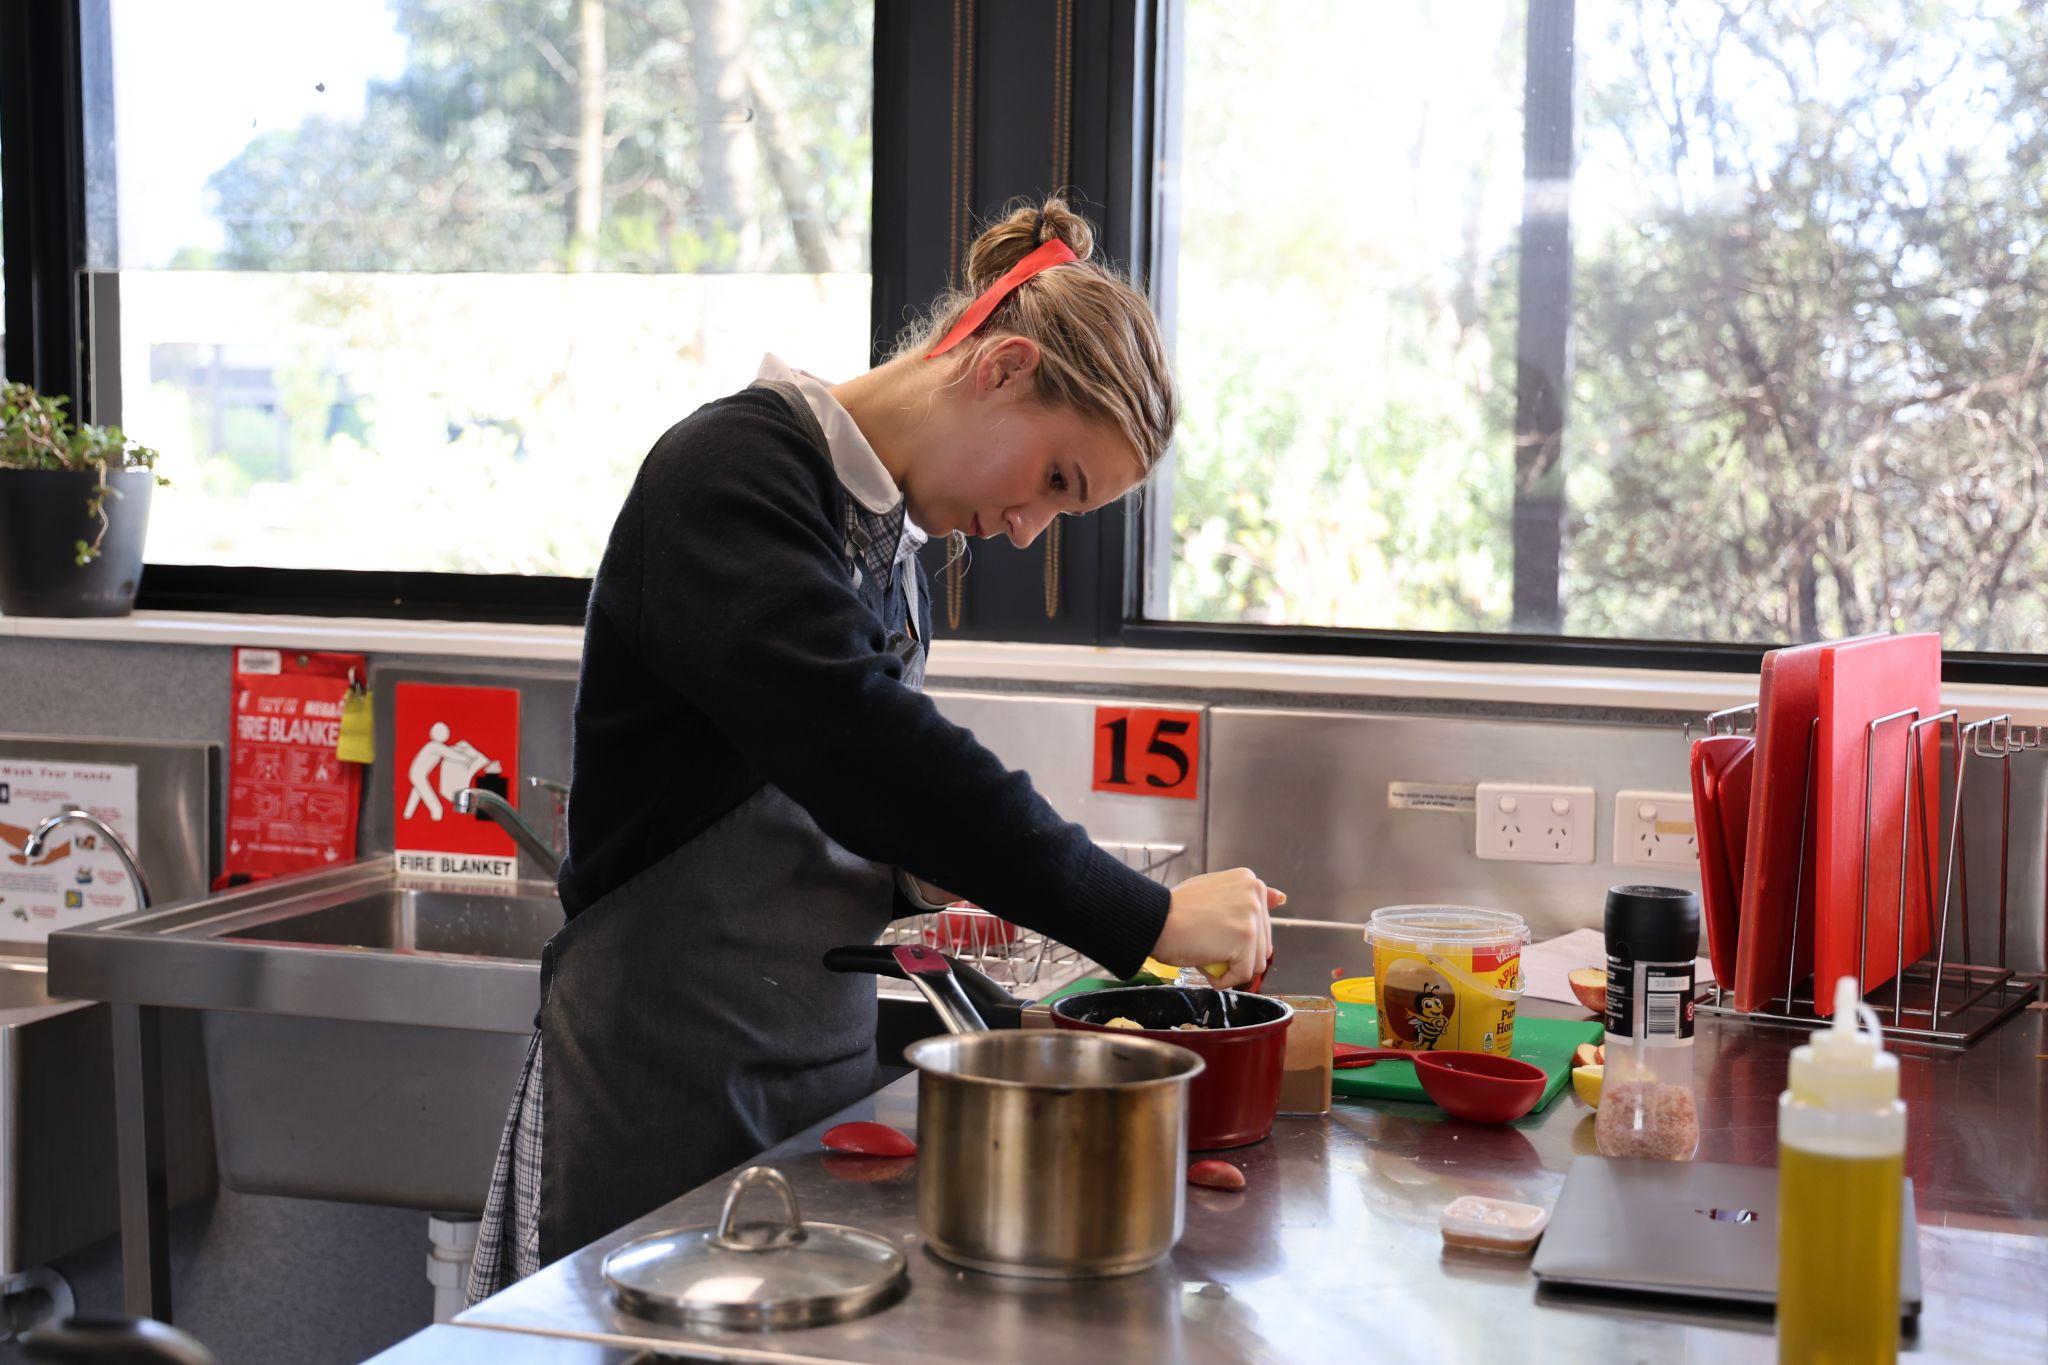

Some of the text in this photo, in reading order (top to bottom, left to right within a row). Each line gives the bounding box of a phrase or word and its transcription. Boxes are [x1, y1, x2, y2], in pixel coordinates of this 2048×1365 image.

[269, 717, 341, 748] BLANKE
[1100, 716, 1190, 788] 15
[399, 856, 512, 877] FIRE BLANKET
[1495, 963, 1519, 990] APIL
[1501, 1007, 1516, 1021] Pur
